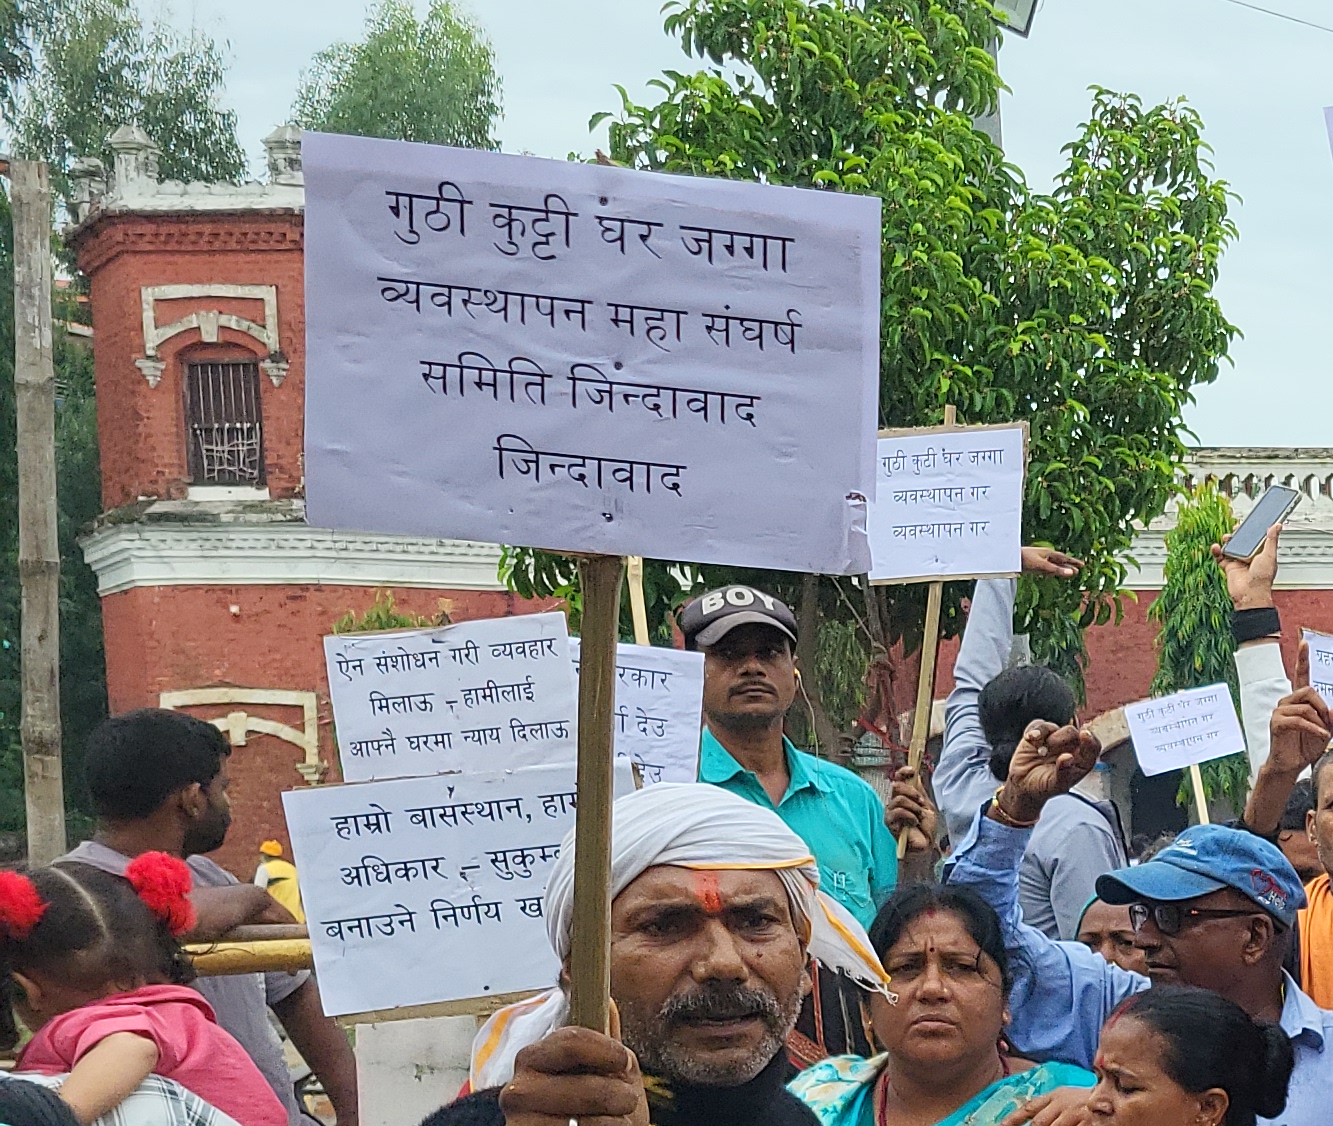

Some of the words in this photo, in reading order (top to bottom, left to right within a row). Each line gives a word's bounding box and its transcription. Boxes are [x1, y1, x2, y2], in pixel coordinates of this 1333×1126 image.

[385, 181, 474, 246] गुठी
[488, 194, 578, 261] कुट्टी
[679, 225, 795, 274] जग्गा
[377, 277, 593, 332] व्यवस्थापन
[607, 301, 688, 352] महा
[701, 304, 802, 355] संघर्ष
[419, 352, 552, 407] समिति
[493, 433, 687, 497] जिन्दावाद
[881, 449, 907, 477] गुठी
[968, 449, 1005, 466] जग्गा
[893, 487, 966, 505] व्यवस्थापन
[970, 485, 991, 501] गर
[892, 522, 965, 540] व्यवस्थापन
[969, 521, 991, 537] गर
[702, 587, 776, 615] BOY
[336, 653, 366, 682] ऐन
[373, 646, 441, 675] संशोधन
[449, 640, 480, 666] गरी
[488, 638, 560, 661] व्यवहार
[369, 691, 435, 716] मिलाऊ
[460, 676, 536, 709] हामीलाई
[615, 665, 673, 692] रकार
[405, 732, 453, 753] घरमा
[461, 727, 501, 746] न्याय
[509, 718, 570, 743] दिलाऊ
[635, 706, 669, 737] देउ
[330, 803, 393, 840] हाम्रो
[340, 855, 448, 887] अधिकार
[320, 903, 418, 941] बनाउने
[429, 894, 503, 930] निर्णय
